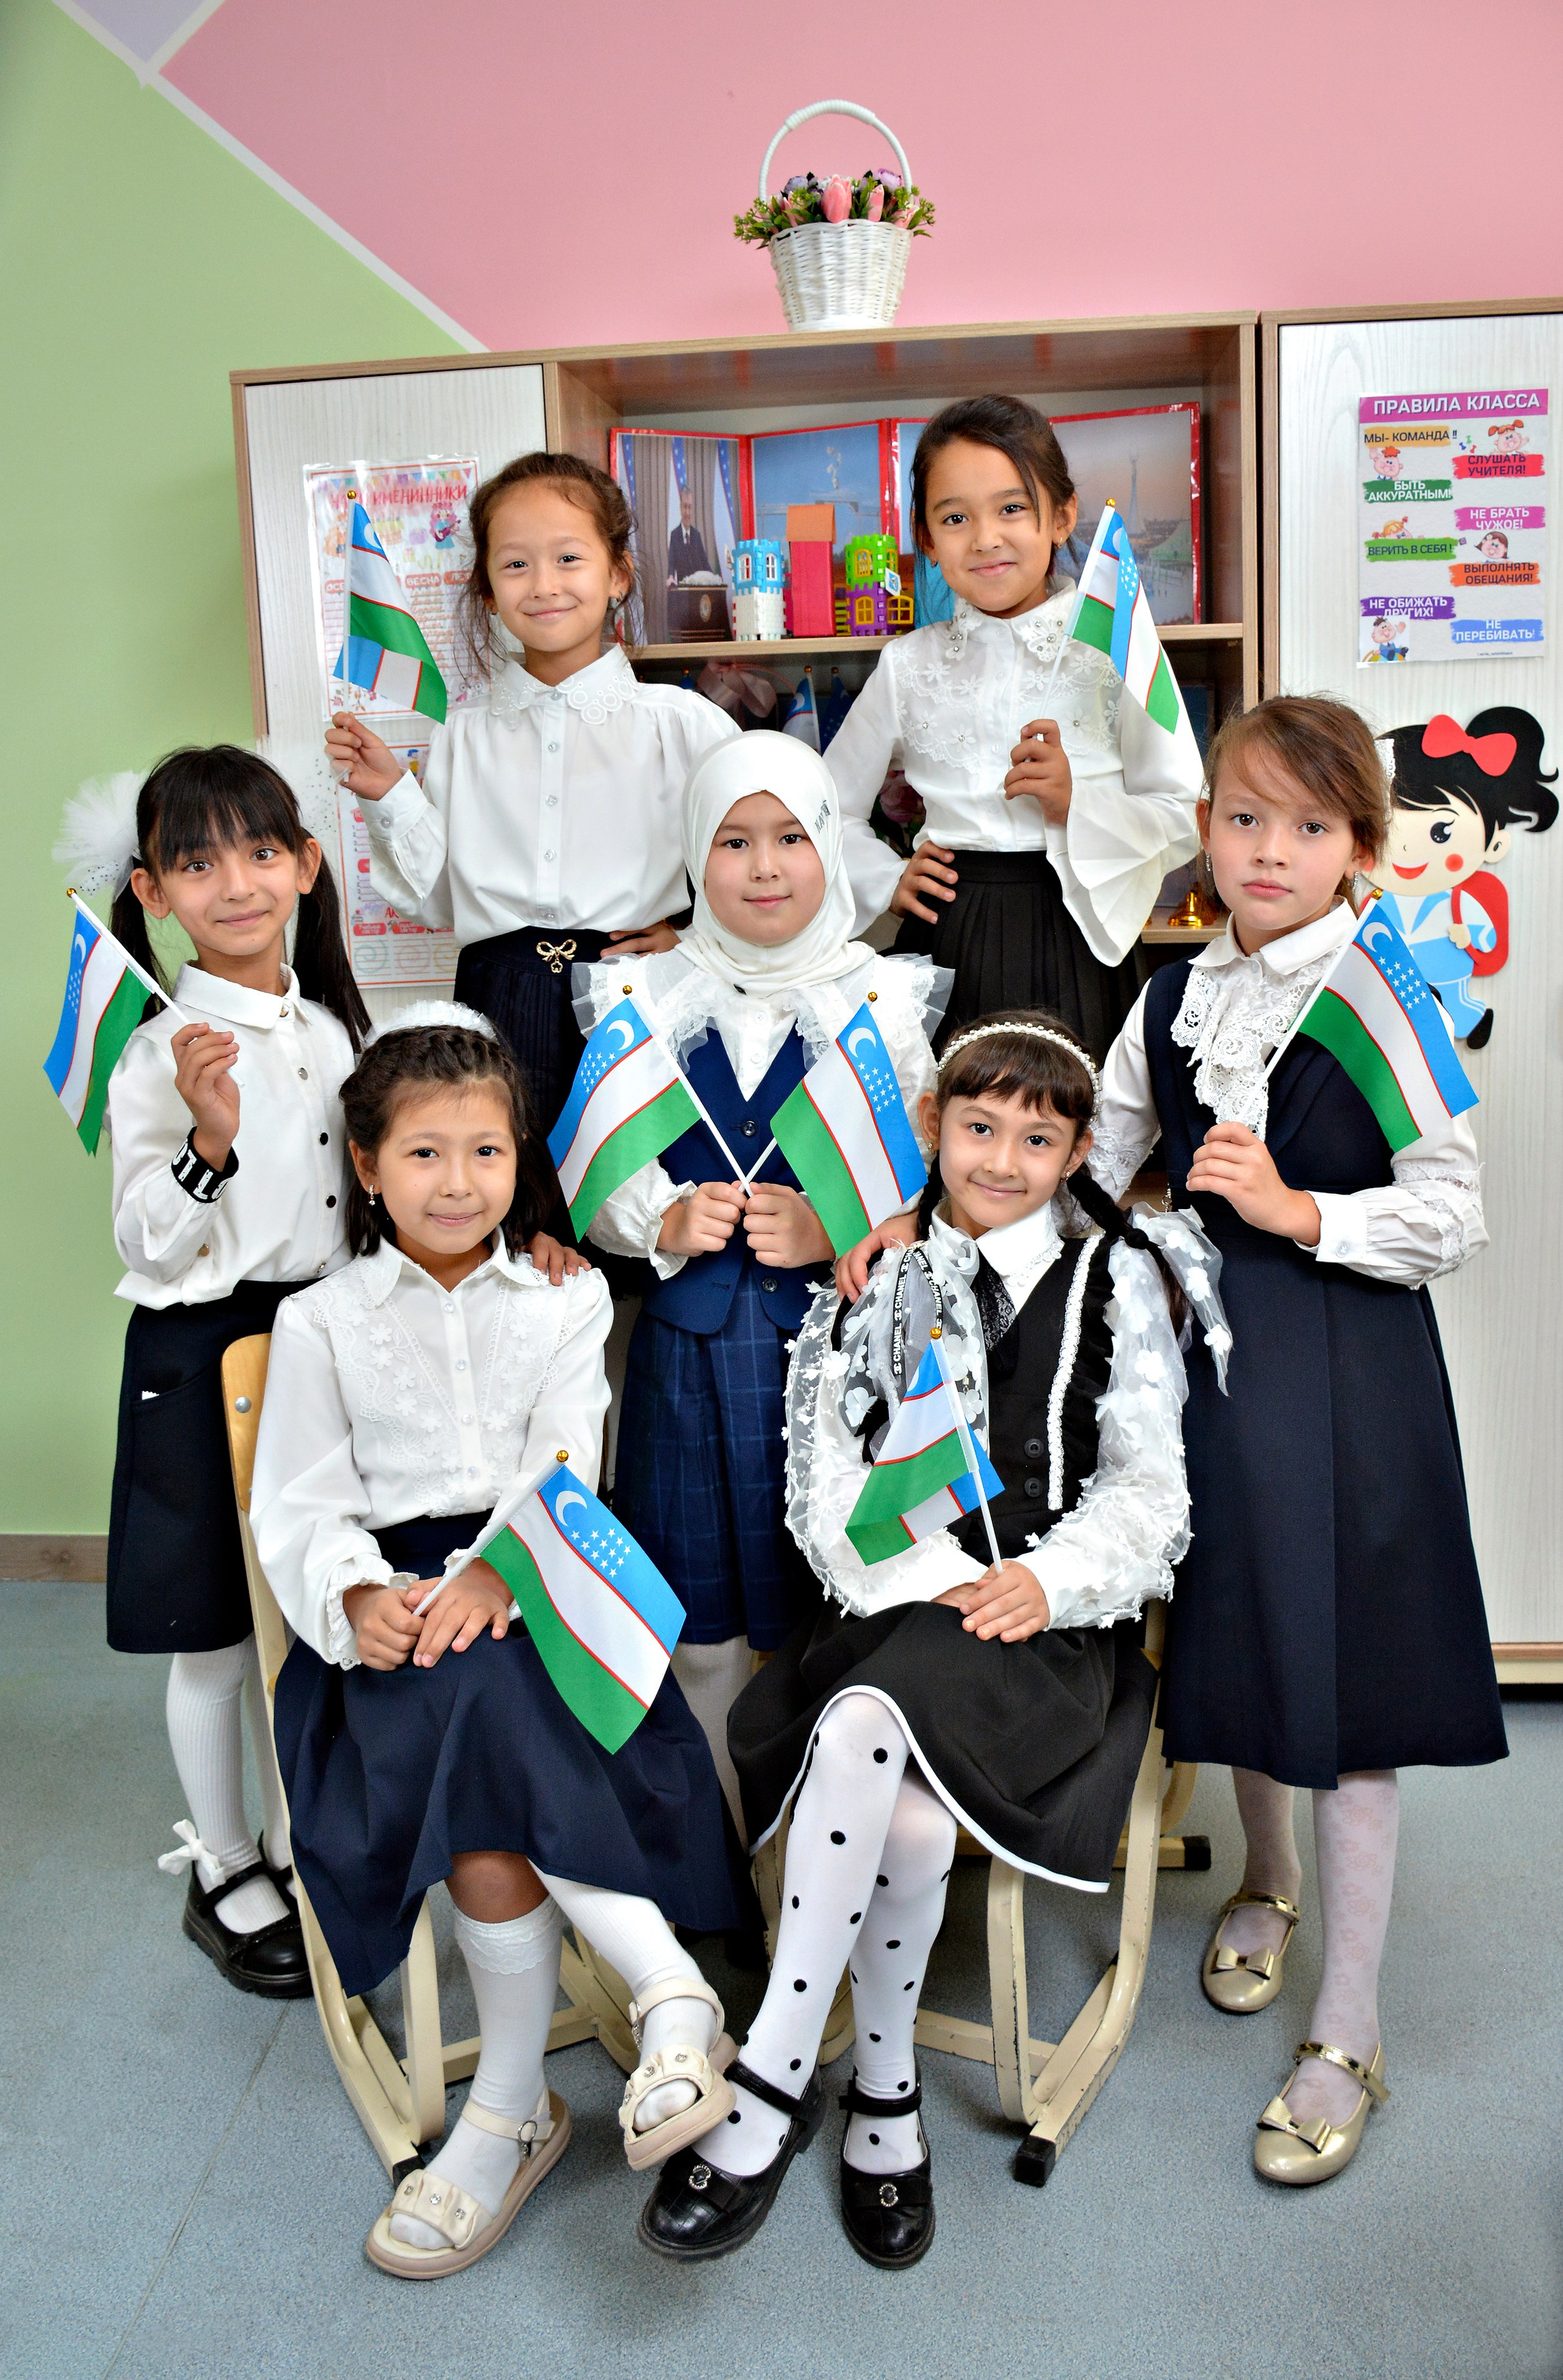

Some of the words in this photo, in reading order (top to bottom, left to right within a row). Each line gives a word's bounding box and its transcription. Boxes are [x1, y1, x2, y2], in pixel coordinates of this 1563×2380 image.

[1374, 397, 1461, 415] ПРАВИЛА
[1467, 393, 1540, 411] КЛАССА
[1392, 431, 1450, 442] КОМАНДА
[1468, 454, 1526, 465] СЛУШАТЬ
[1468, 465, 1526, 476] УЧИТЕЛЯ!
[1394, 480, 1426, 491] БЫТЬ
[372, 484, 467, 506] ИМЕНИННИКИ
[1368, 489, 1452, 501] АККУРАТНЫМ!
[1470, 509, 1487, 519] НЕ
[1490, 507, 1530, 519] БРАТЬ
[1476, 519, 1523, 530] ЧУЖОЕ!
[1368, 545, 1409, 556] ВЕРИТЬ
[1411, 545, 1418, 554] В
[1420, 544, 1447, 554] СЕБЯ
[1463, 562, 1535, 573] ВЫПОЛНЯТЬ
[407, 576, 440, 586] ВЕСНА
[1465, 573, 1533, 585] ОБЕЩАНИЯ!
[1369, 599, 1385, 609] НЕ
[1388, 597, 1448, 608] ОБИЖАТЬ
[1486, 619, 1501, 629] НЕ
[1456, 629, 1535, 641] ПЕРЕБИВАТЬ!
[894, 1273, 907, 1309] CHANEL
[929, 1280, 943, 1316] CHANEL
[893, 1322, 902, 1362] CHANEL
